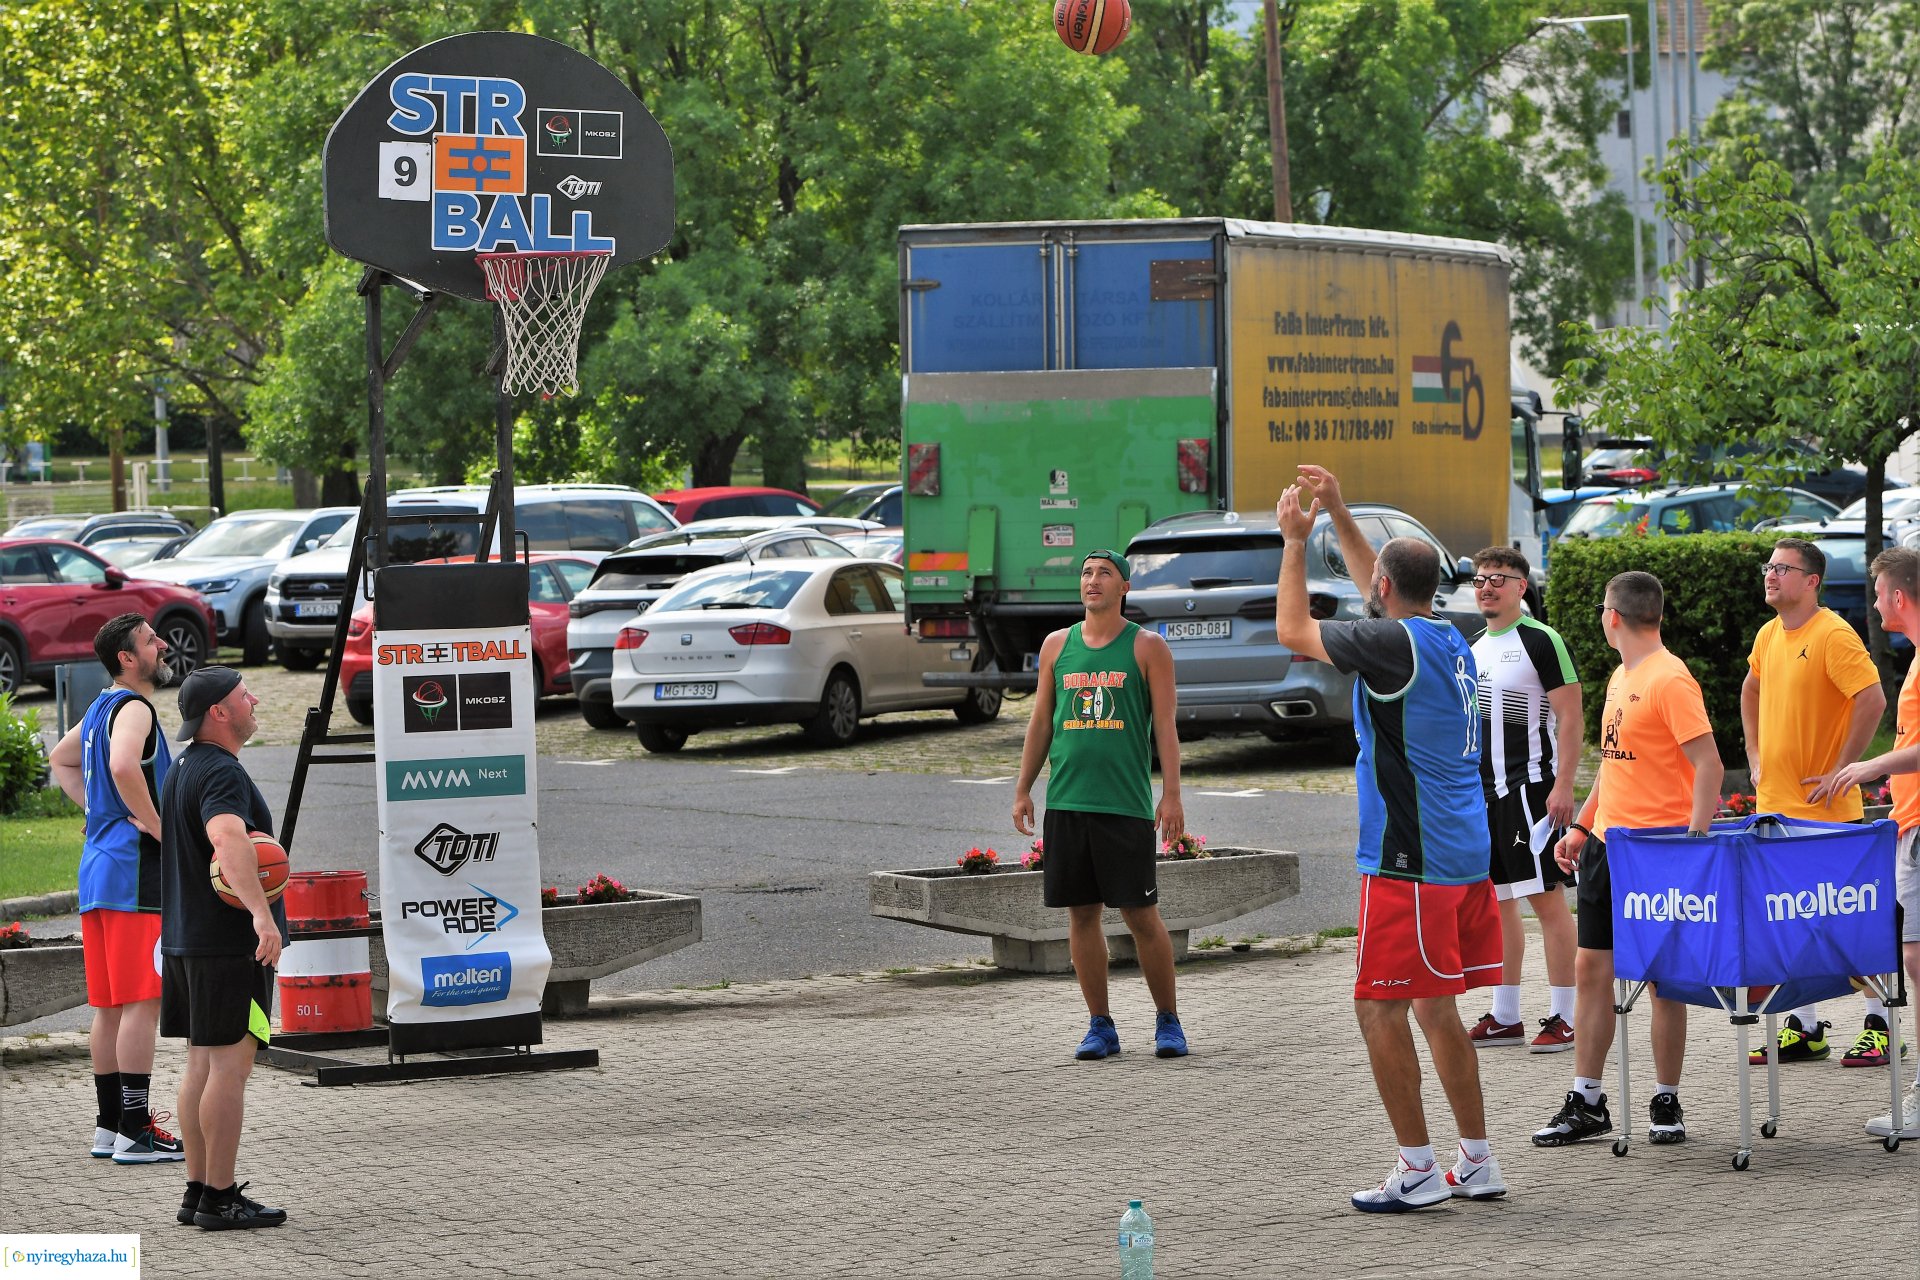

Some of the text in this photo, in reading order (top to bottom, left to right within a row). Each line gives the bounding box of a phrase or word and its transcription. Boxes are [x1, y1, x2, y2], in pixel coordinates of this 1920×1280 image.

[394, 156, 418, 187] 9
[566, 180, 603, 195] TOTI
[431, 191, 616, 256] BALL
[1267, 352, 1394, 374] www.fabaintertrans.hu
[1263, 386, 1398, 409] fabaintertrans@chello.hu
[1295, 420, 1310, 441] 00
[1314, 420, 1328, 440] 36
[664, 684, 714, 697] MGT-339
[1063, 671, 1127, 690] BORACAY
[465, 696, 506, 705] MKOSZ
[401, 768, 508, 790] MVM Next
[433, 831, 501, 863] TOTI
[401, 897, 499, 919] POWER
[1624, 887, 1717, 923] molten
[1766, 882, 1877, 922] molten
[442, 915, 497, 934] ADE
[434, 967, 502, 988] molten
[1371, 978, 1411, 986] KIX
[432, 985, 501, 998] For the real game
[297, 1004, 323, 1016] 50 L
